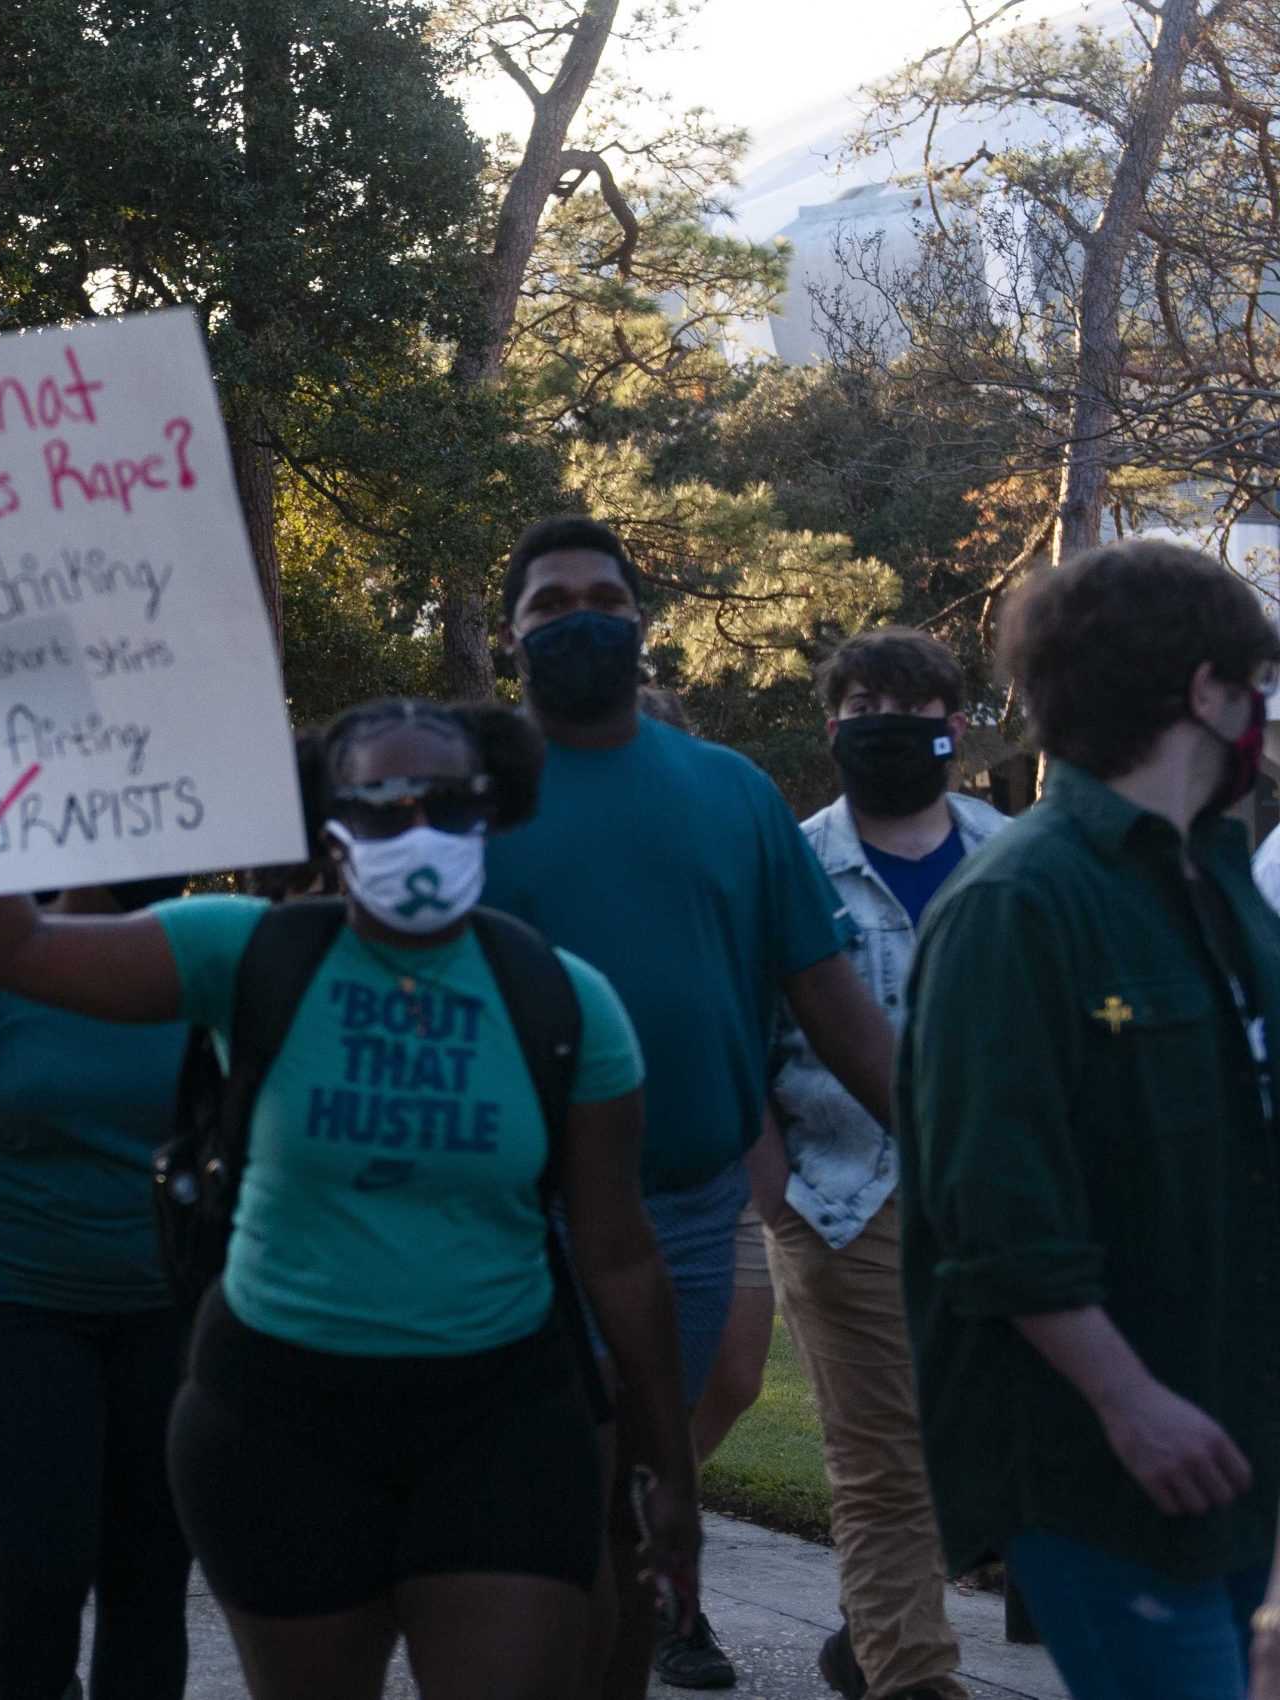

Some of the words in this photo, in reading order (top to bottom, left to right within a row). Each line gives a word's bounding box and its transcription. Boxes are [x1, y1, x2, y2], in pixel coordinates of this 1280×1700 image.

[44, 418, 197, 513] Rape?
[21, 776, 205, 850] RAPISTS
[341, 1035, 477, 1094] THAT
[307, 1087, 502, 1154] HUSTLE
